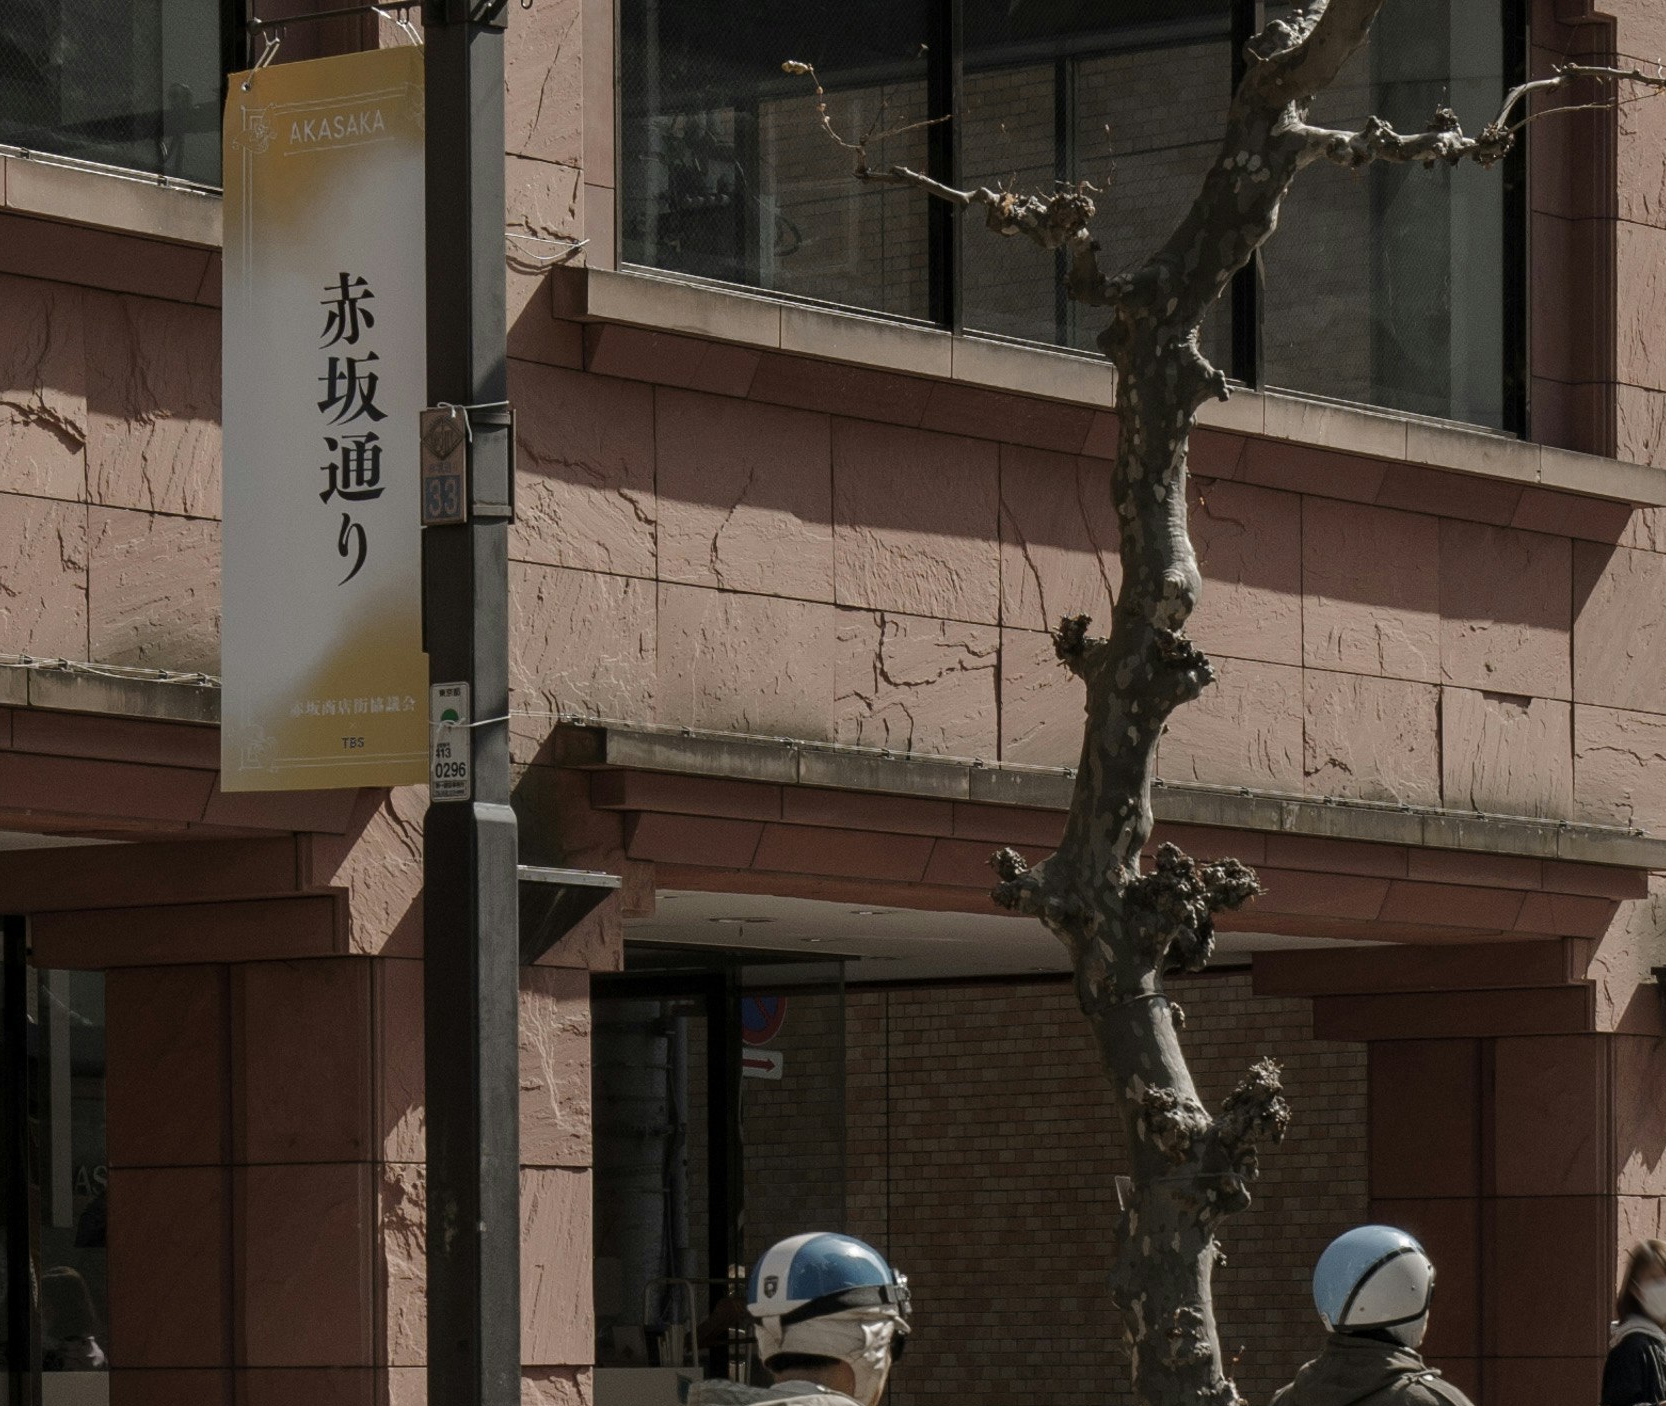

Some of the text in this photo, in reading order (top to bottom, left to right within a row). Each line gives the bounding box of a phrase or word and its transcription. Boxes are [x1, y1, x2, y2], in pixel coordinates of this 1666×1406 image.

[290, 110, 385, 144] AKASAKA
[317, 272, 388, 588] 赤坂通り
[341, 737, 365, 749] TBS
[435, 762, 466, 778] 0296
